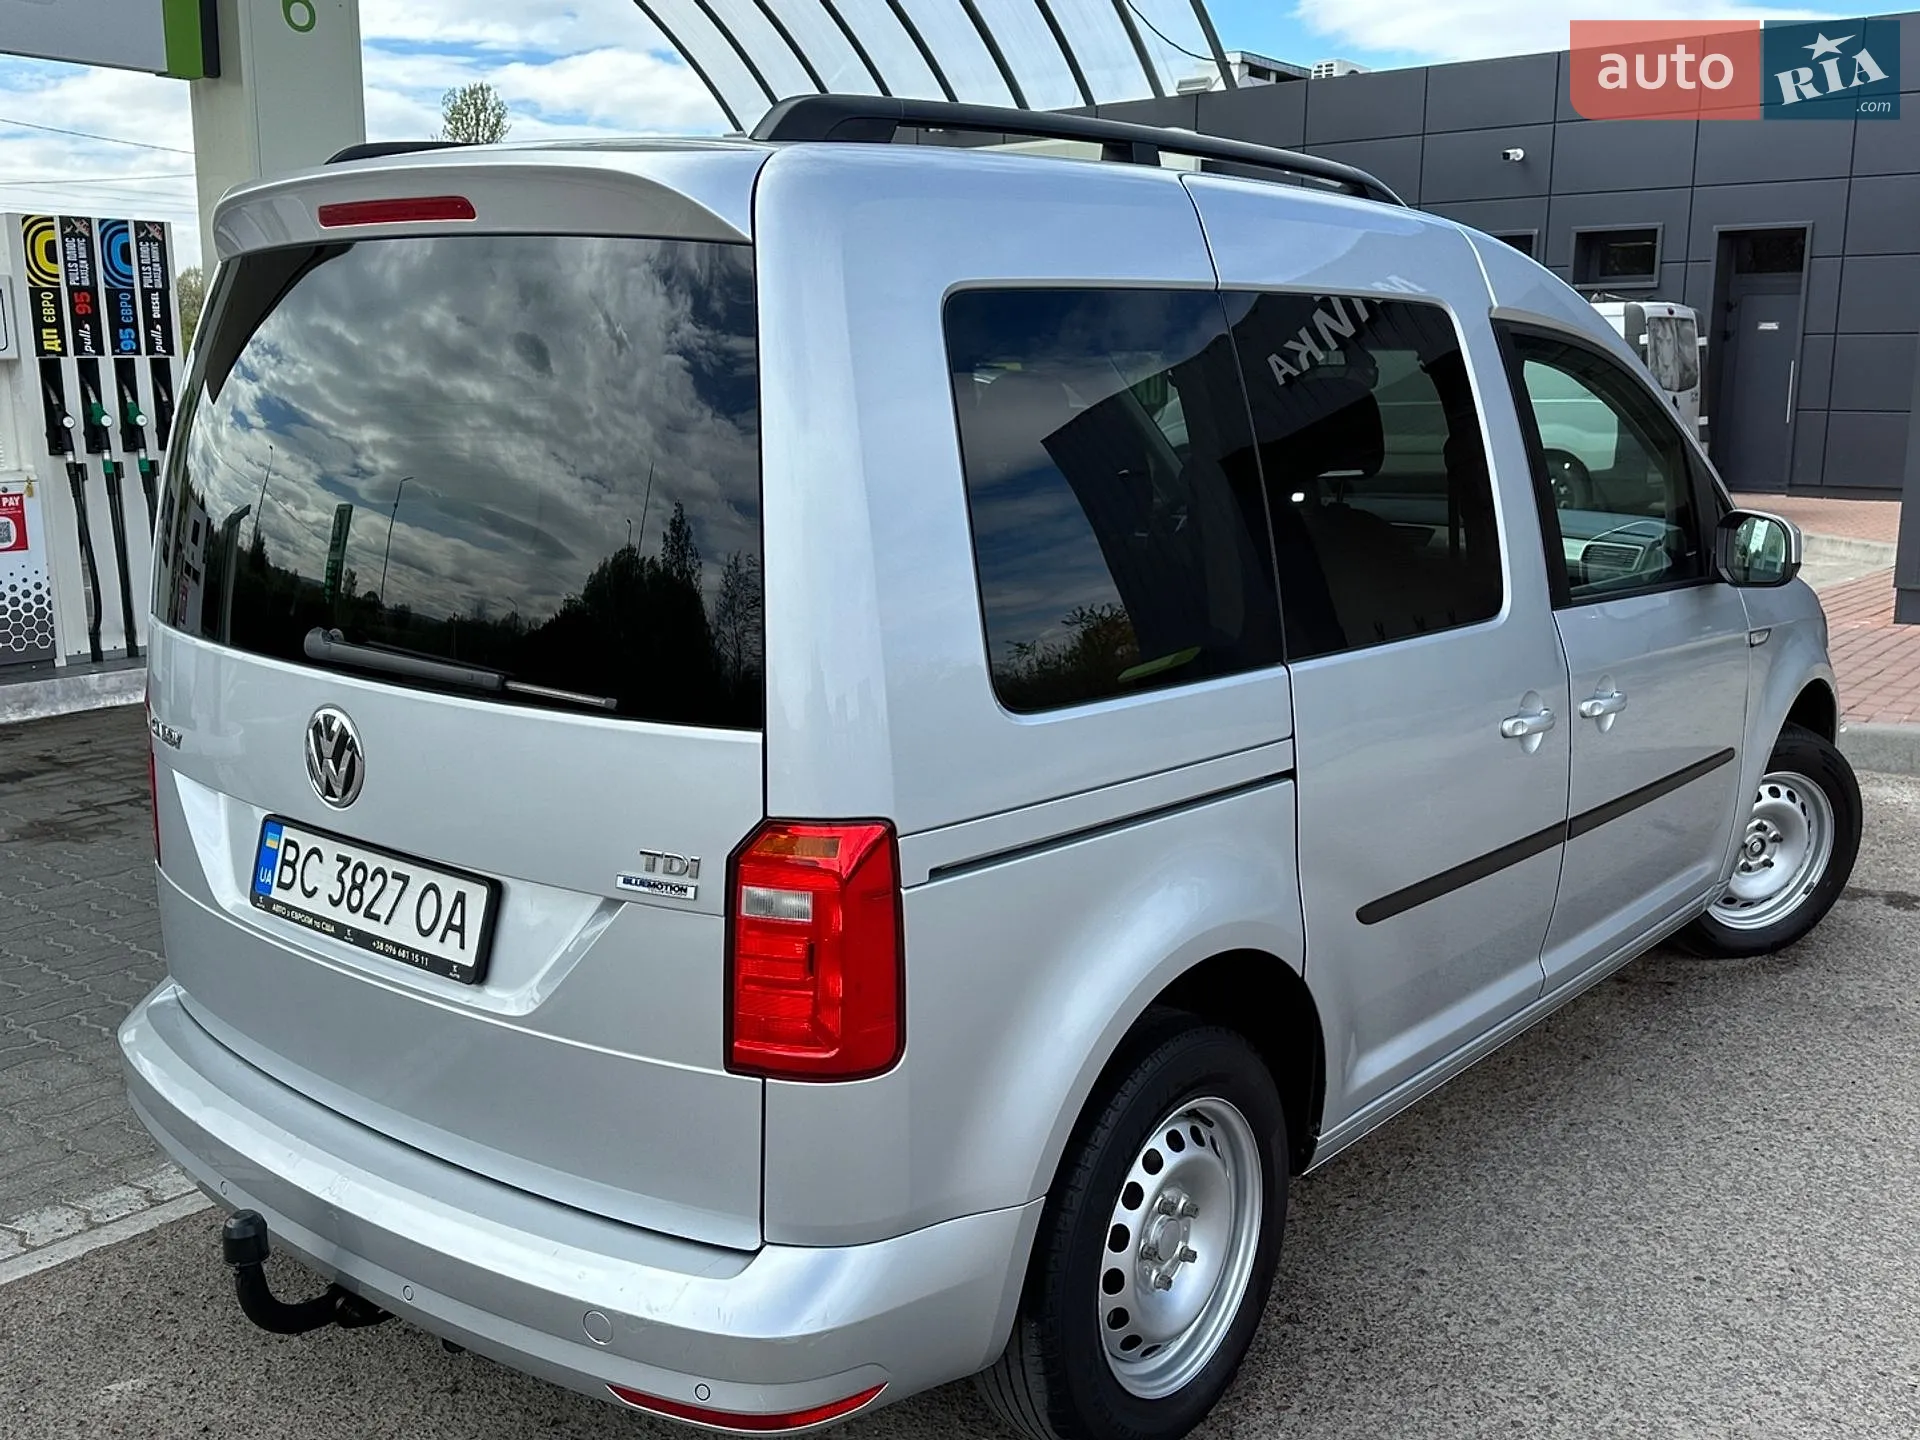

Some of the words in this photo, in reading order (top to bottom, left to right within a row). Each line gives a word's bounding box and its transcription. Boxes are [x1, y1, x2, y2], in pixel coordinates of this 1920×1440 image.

[40, 291, 56, 323] ЄВРО
[74, 291, 92, 315] 95
[119, 292, 134, 323] ЄВРО
[151, 291, 161, 319] DIESEL
[41, 328, 62, 352] ДП
[119, 328, 137, 351] 95
[1, 496, 20, 507] PAY
[259, 868, 273, 886] UA
[276, 838, 324, 899] BC
[328, 854, 411, 926] 3827
[415, 882, 467, 950] OA
